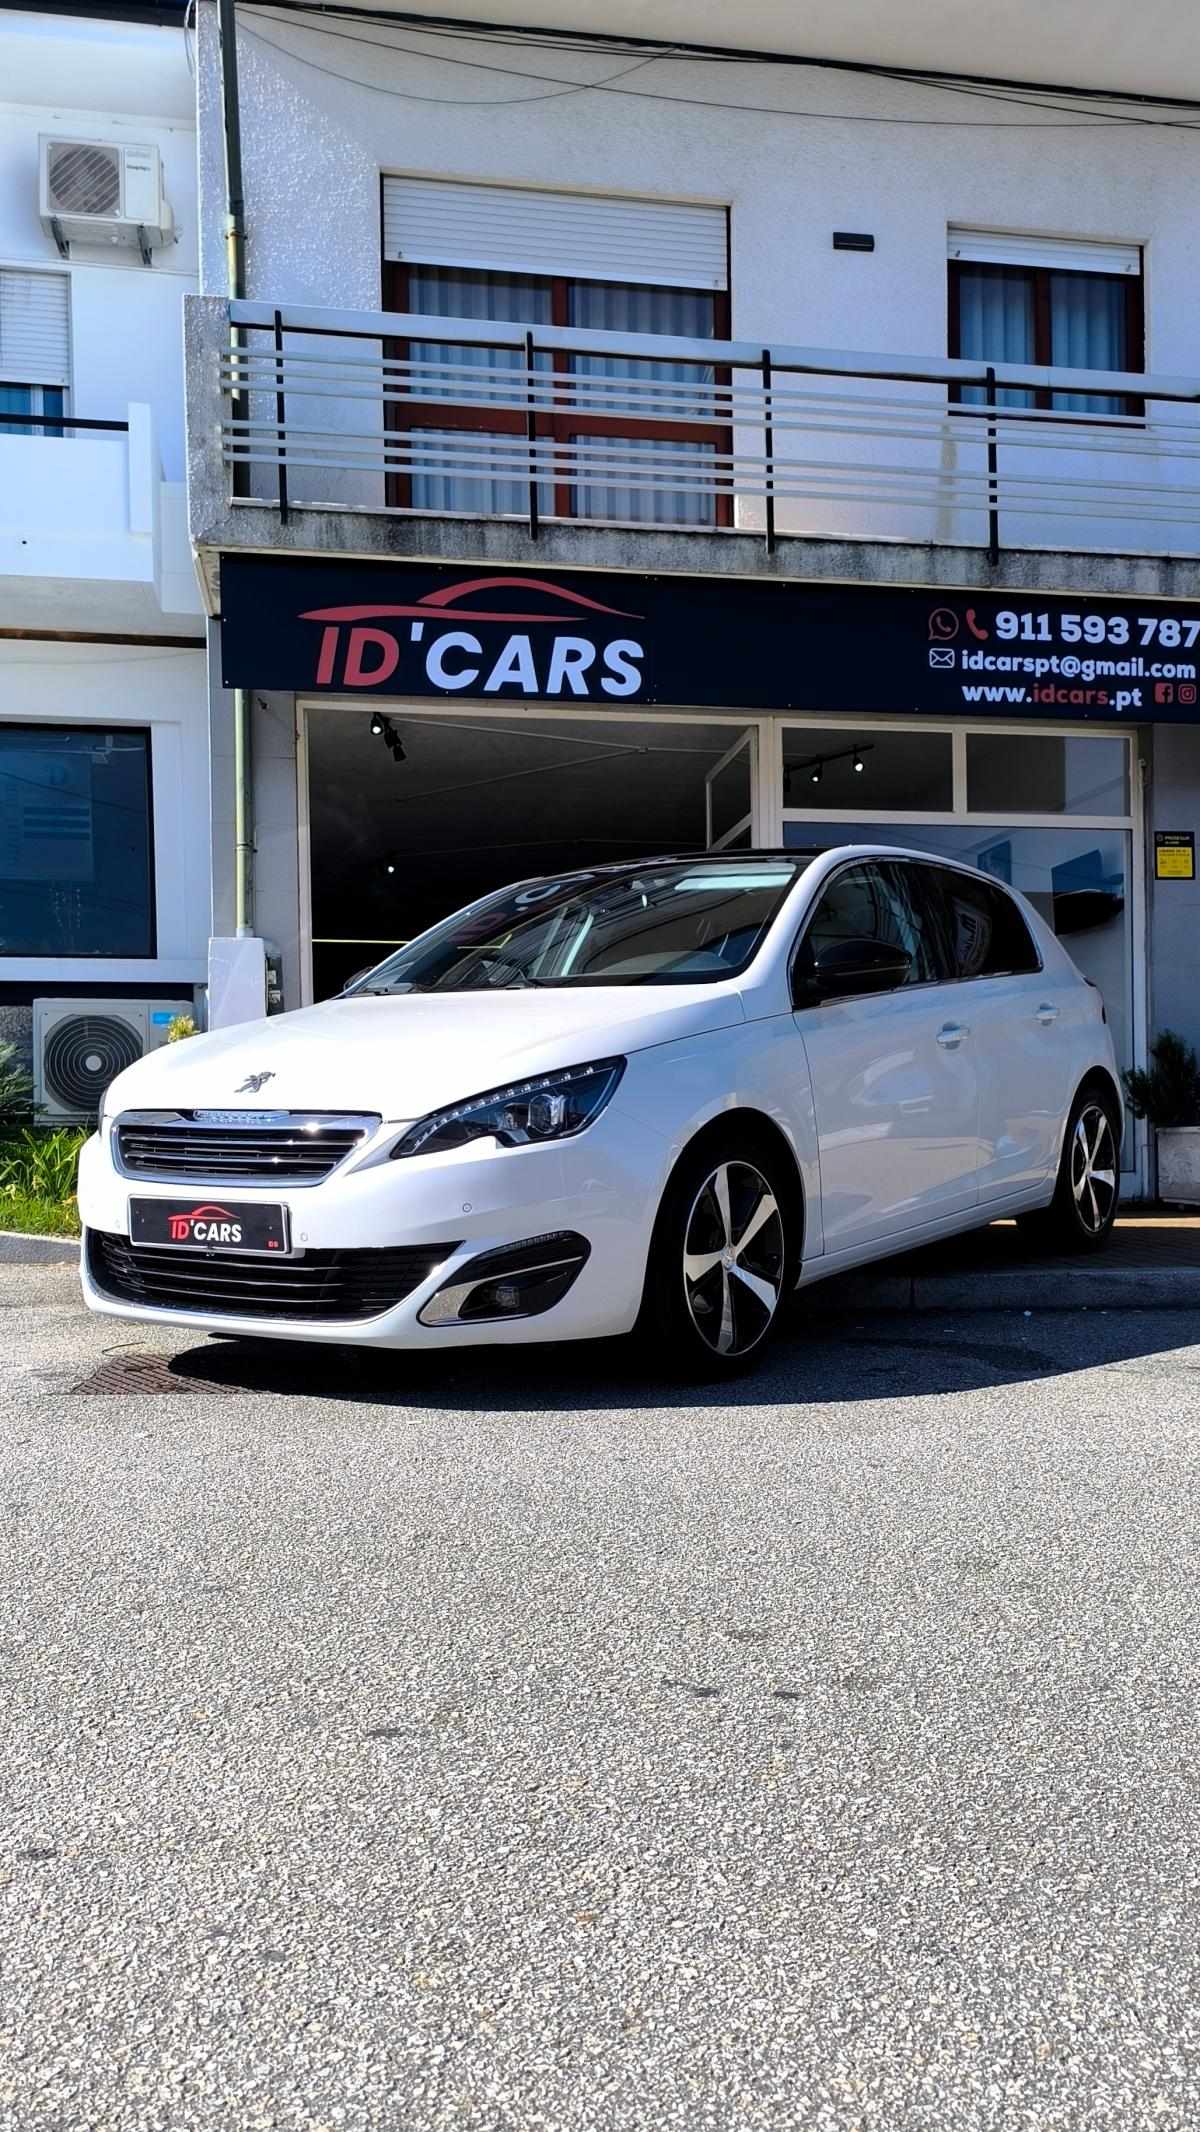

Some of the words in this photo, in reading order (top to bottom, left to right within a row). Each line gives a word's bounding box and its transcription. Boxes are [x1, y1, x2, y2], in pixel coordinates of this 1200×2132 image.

[995, 611, 1052, 641] 911
[1060, 614, 1130, 645] 593
[1137, 618, 1200, 648] 787
[316, 622, 645, 697] ID'CARS
[961, 649, 1196, 681] idcarspt@gmail.com
[961, 683, 1143, 711] www.idcars.pt
[171, 1219, 242, 1243] ID'CARS
